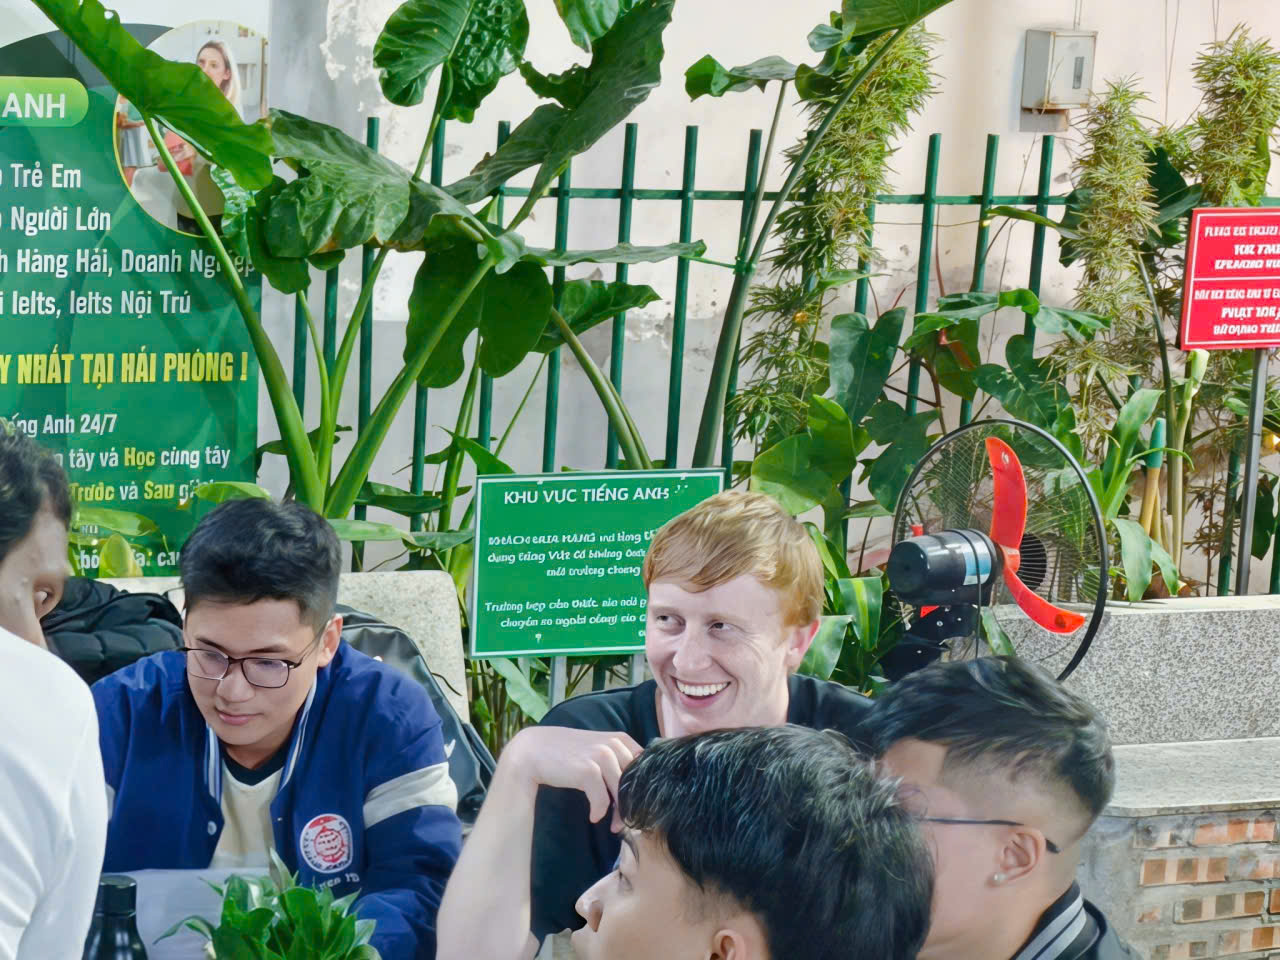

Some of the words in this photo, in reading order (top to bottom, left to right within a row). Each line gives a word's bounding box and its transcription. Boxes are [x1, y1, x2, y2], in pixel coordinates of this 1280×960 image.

[1, 92, 66, 119] ANH
[10, 160, 43, 188] Trẻ
[51, 163, 82, 188] Em
[10, 205, 68, 237] Người
[75, 205, 111, 231] Lớn
[121, 249, 182, 273] Doanh
[12, 290, 61, 319] Ielts,
[69, 289, 113, 315] Ielts
[120, 290, 152, 319] Nội
[159, 290, 191, 314] Trú
[80, 353, 115, 390] TẠI
[42, 413, 75, 434] Anh
[80, 413, 118, 436] 24/7
[124, 447, 156, 470] Học
[144, 480, 174, 499] Sau
[503, 490, 539, 505] KHU
